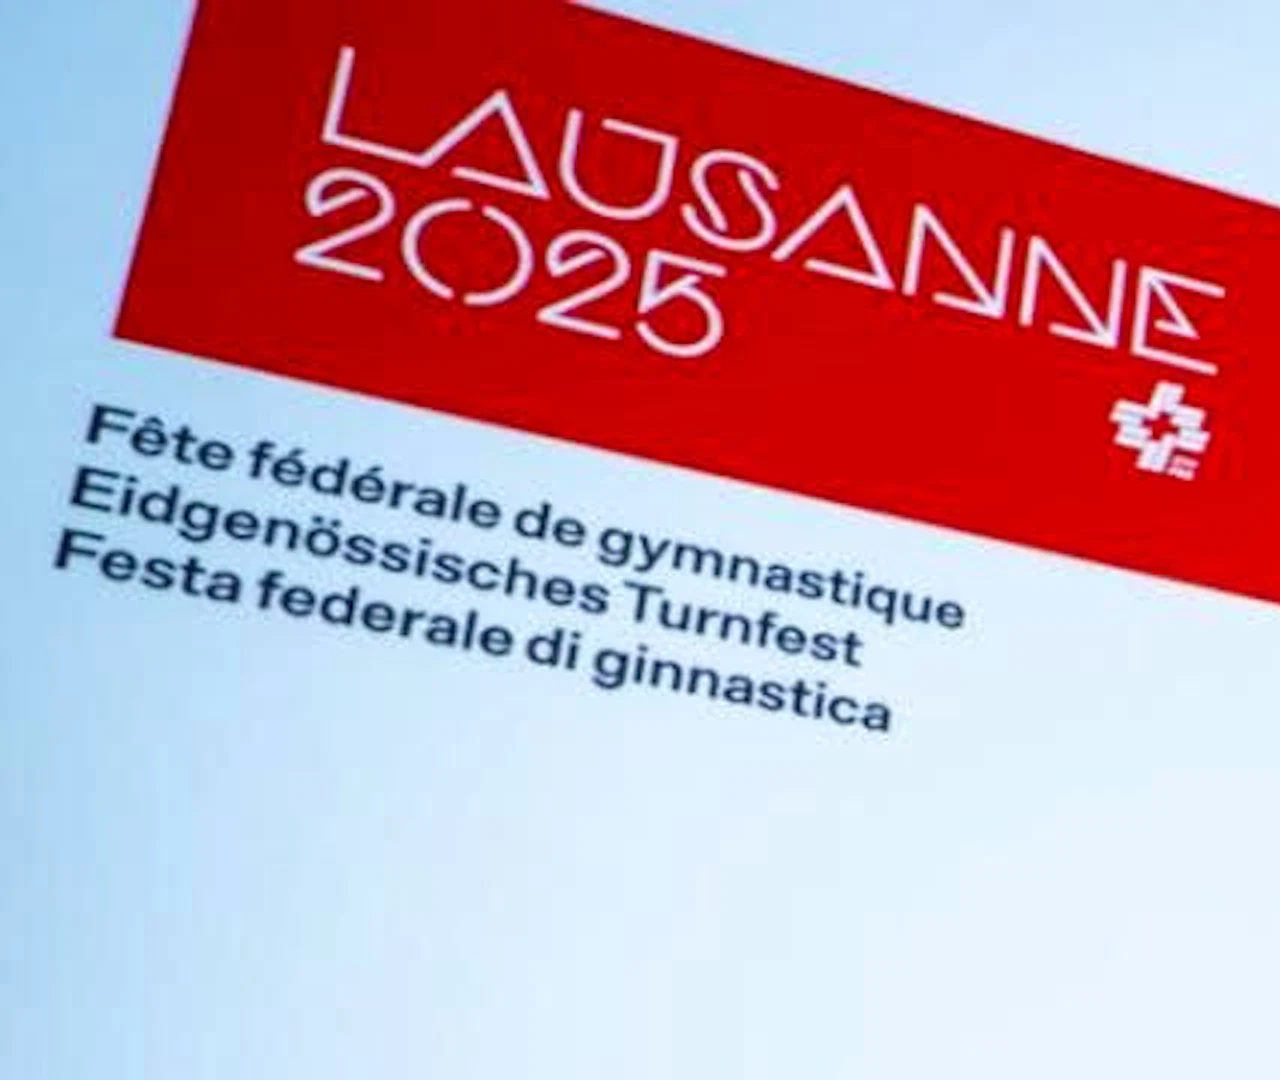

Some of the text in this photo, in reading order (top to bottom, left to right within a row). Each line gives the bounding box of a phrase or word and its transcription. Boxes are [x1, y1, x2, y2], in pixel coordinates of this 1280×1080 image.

[294, 166, 727, 358] 2025
[321, 45, 1226, 374] LAUSANNE
[69, 465, 864, 668] Eidgenössisches Turnfest
[83, 402, 966, 630] Fête fédérale de gymnastique
[52, 528, 893, 733] Festa federale di ginnastica
